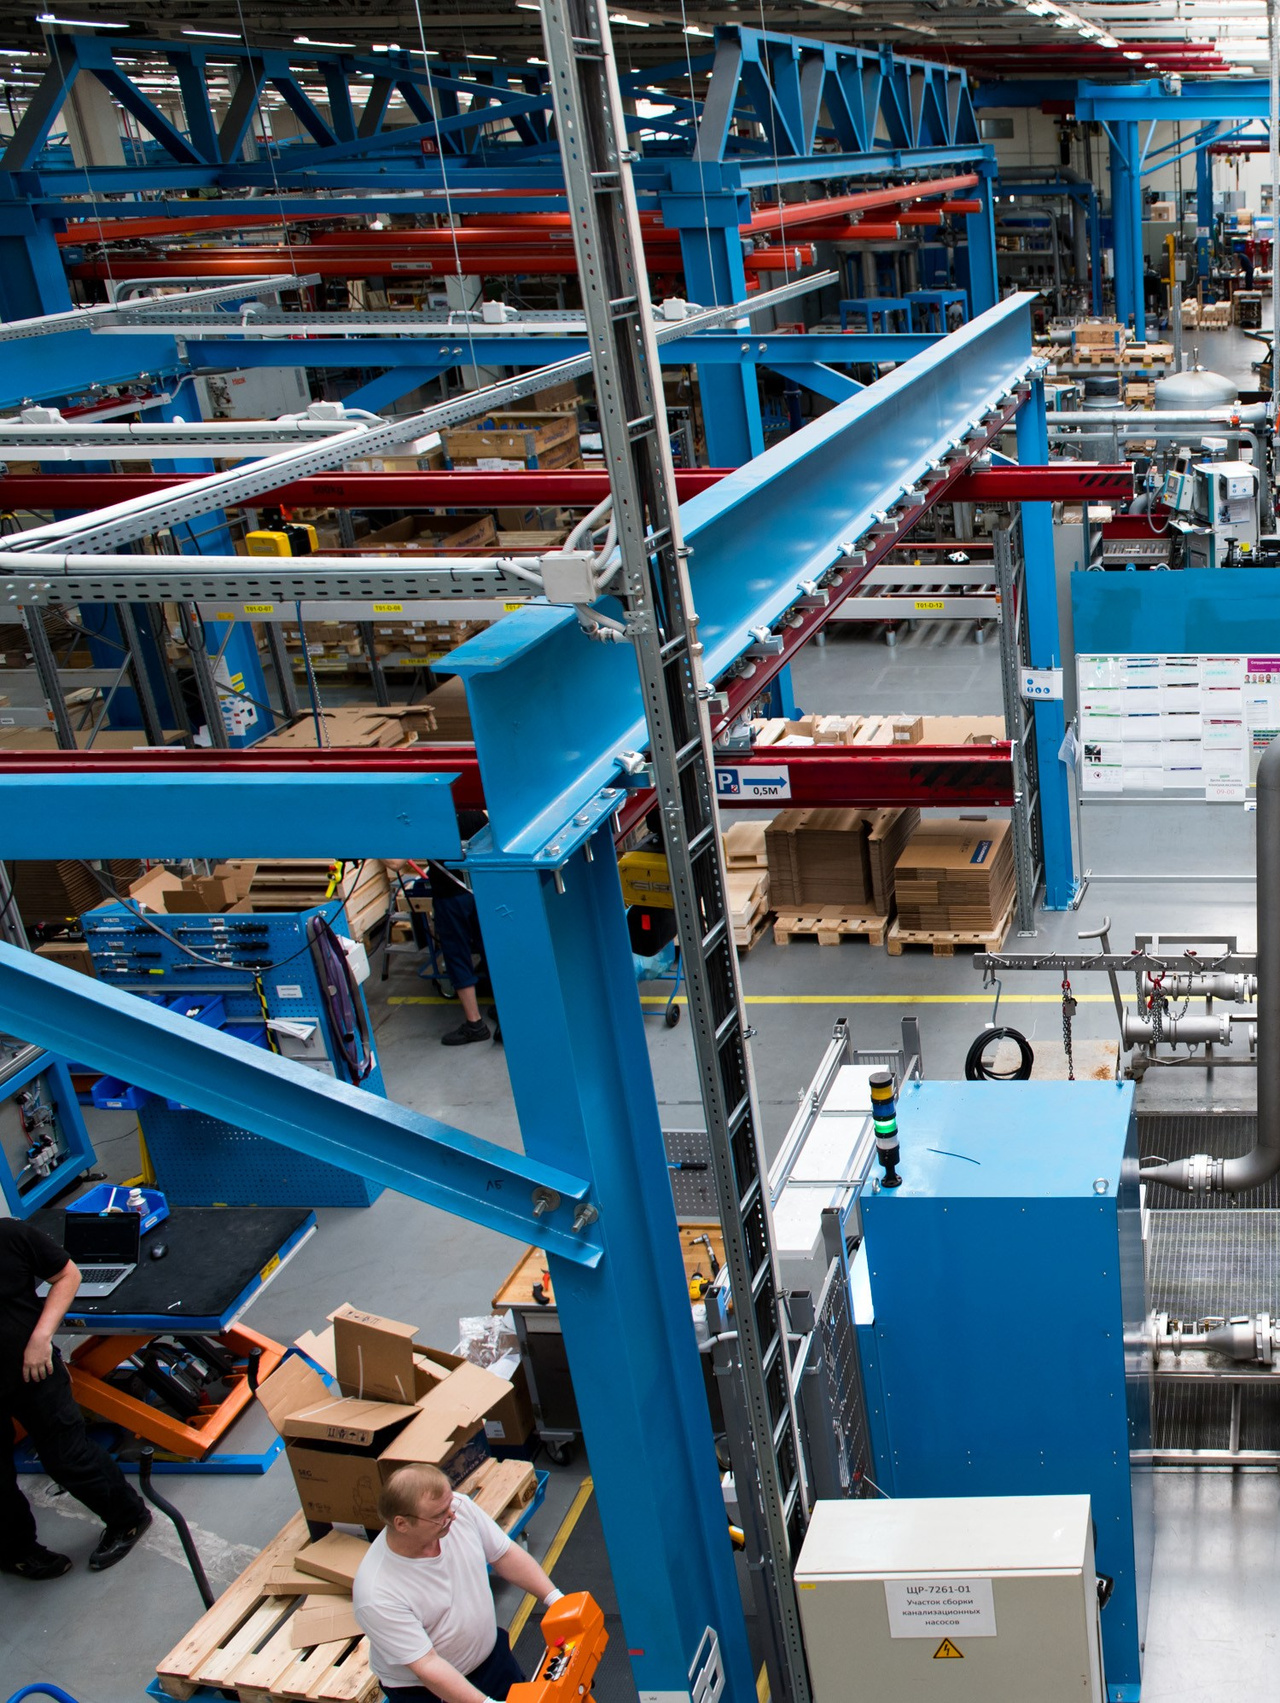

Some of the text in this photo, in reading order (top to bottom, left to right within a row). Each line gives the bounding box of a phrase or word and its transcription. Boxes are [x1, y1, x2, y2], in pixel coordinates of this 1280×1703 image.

[718, 773, 732, 791] P
[906, 1585, 971, 1595] ЩР-7261-01
[902, 1608, 981, 1616] канализационных
